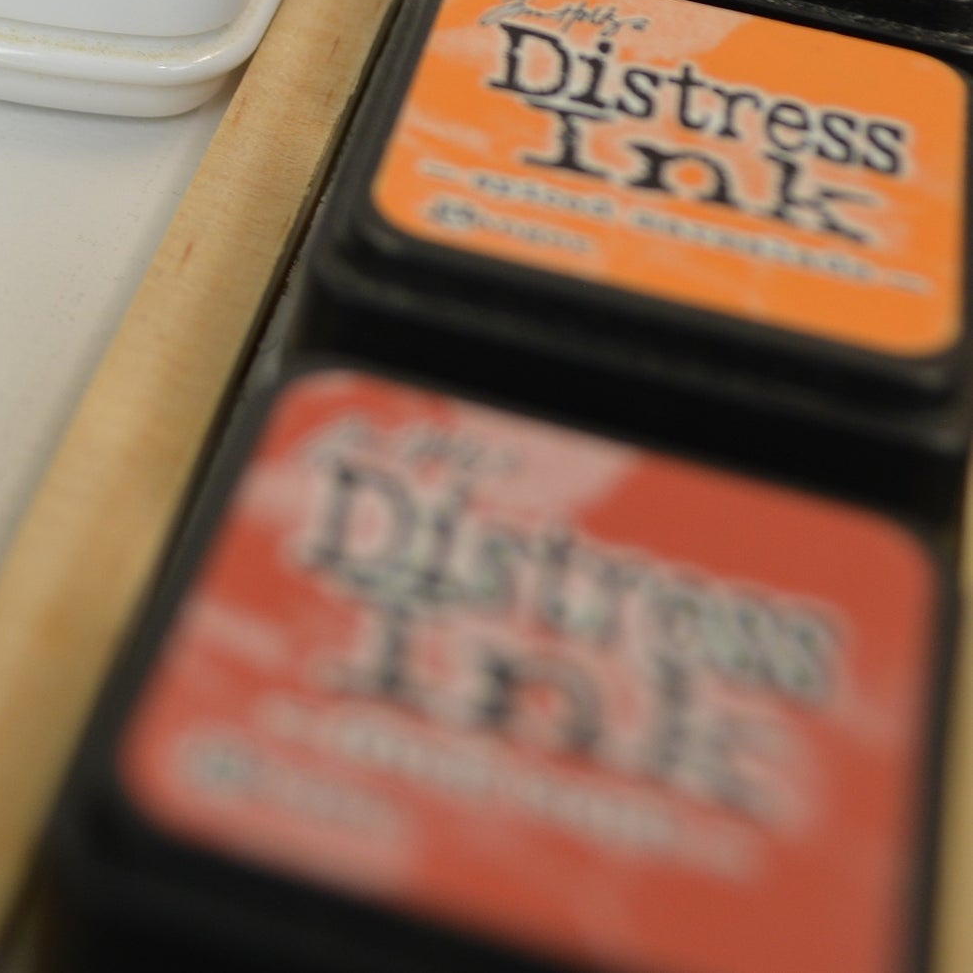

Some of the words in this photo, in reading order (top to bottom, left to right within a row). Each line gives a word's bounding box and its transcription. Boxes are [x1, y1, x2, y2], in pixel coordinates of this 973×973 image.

[488, 21, 907, 177] Distress
[521, 94, 880, 246] Ink
[295, 457, 843, 713] Distress
[312, 592, 812, 833] Ink
